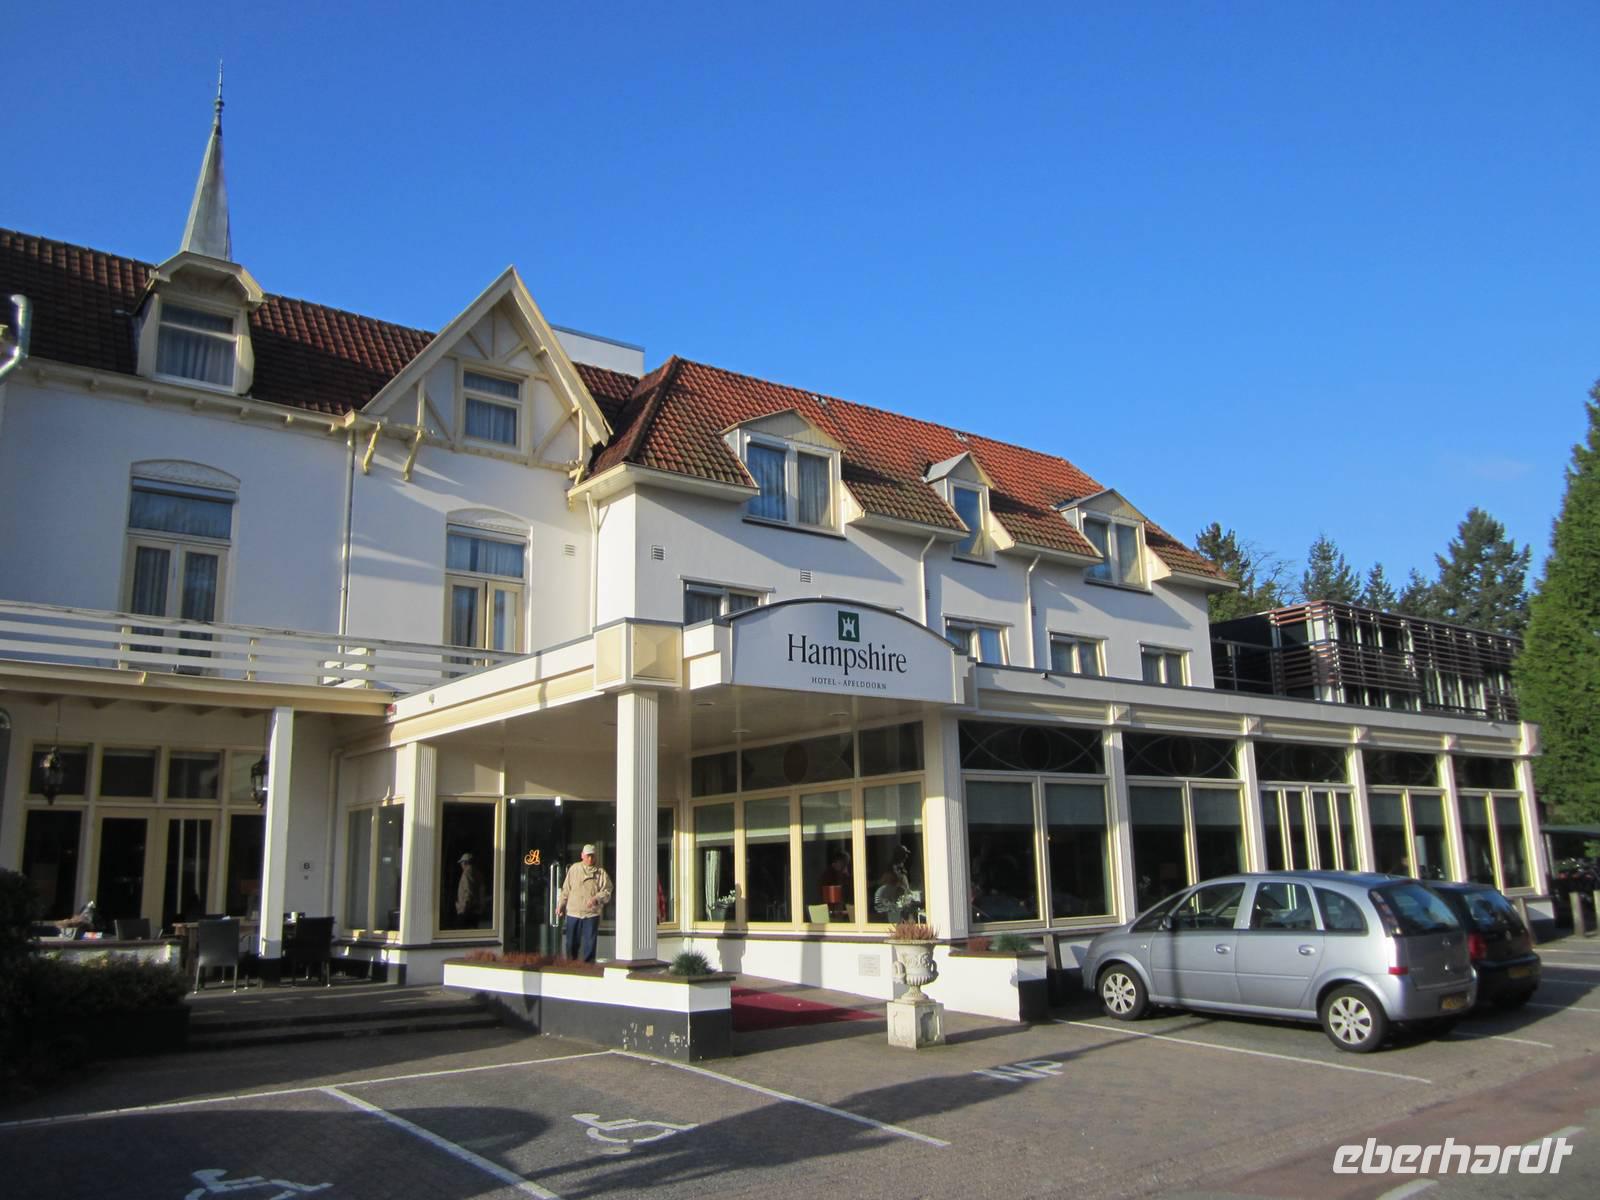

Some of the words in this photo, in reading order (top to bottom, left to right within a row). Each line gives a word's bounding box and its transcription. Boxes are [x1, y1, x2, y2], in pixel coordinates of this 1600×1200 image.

[787, 633, 907, 675] Hampshire
[811, 676, 837, 686] HOTEL
[843, 680, 887, 690] APELDOORN
